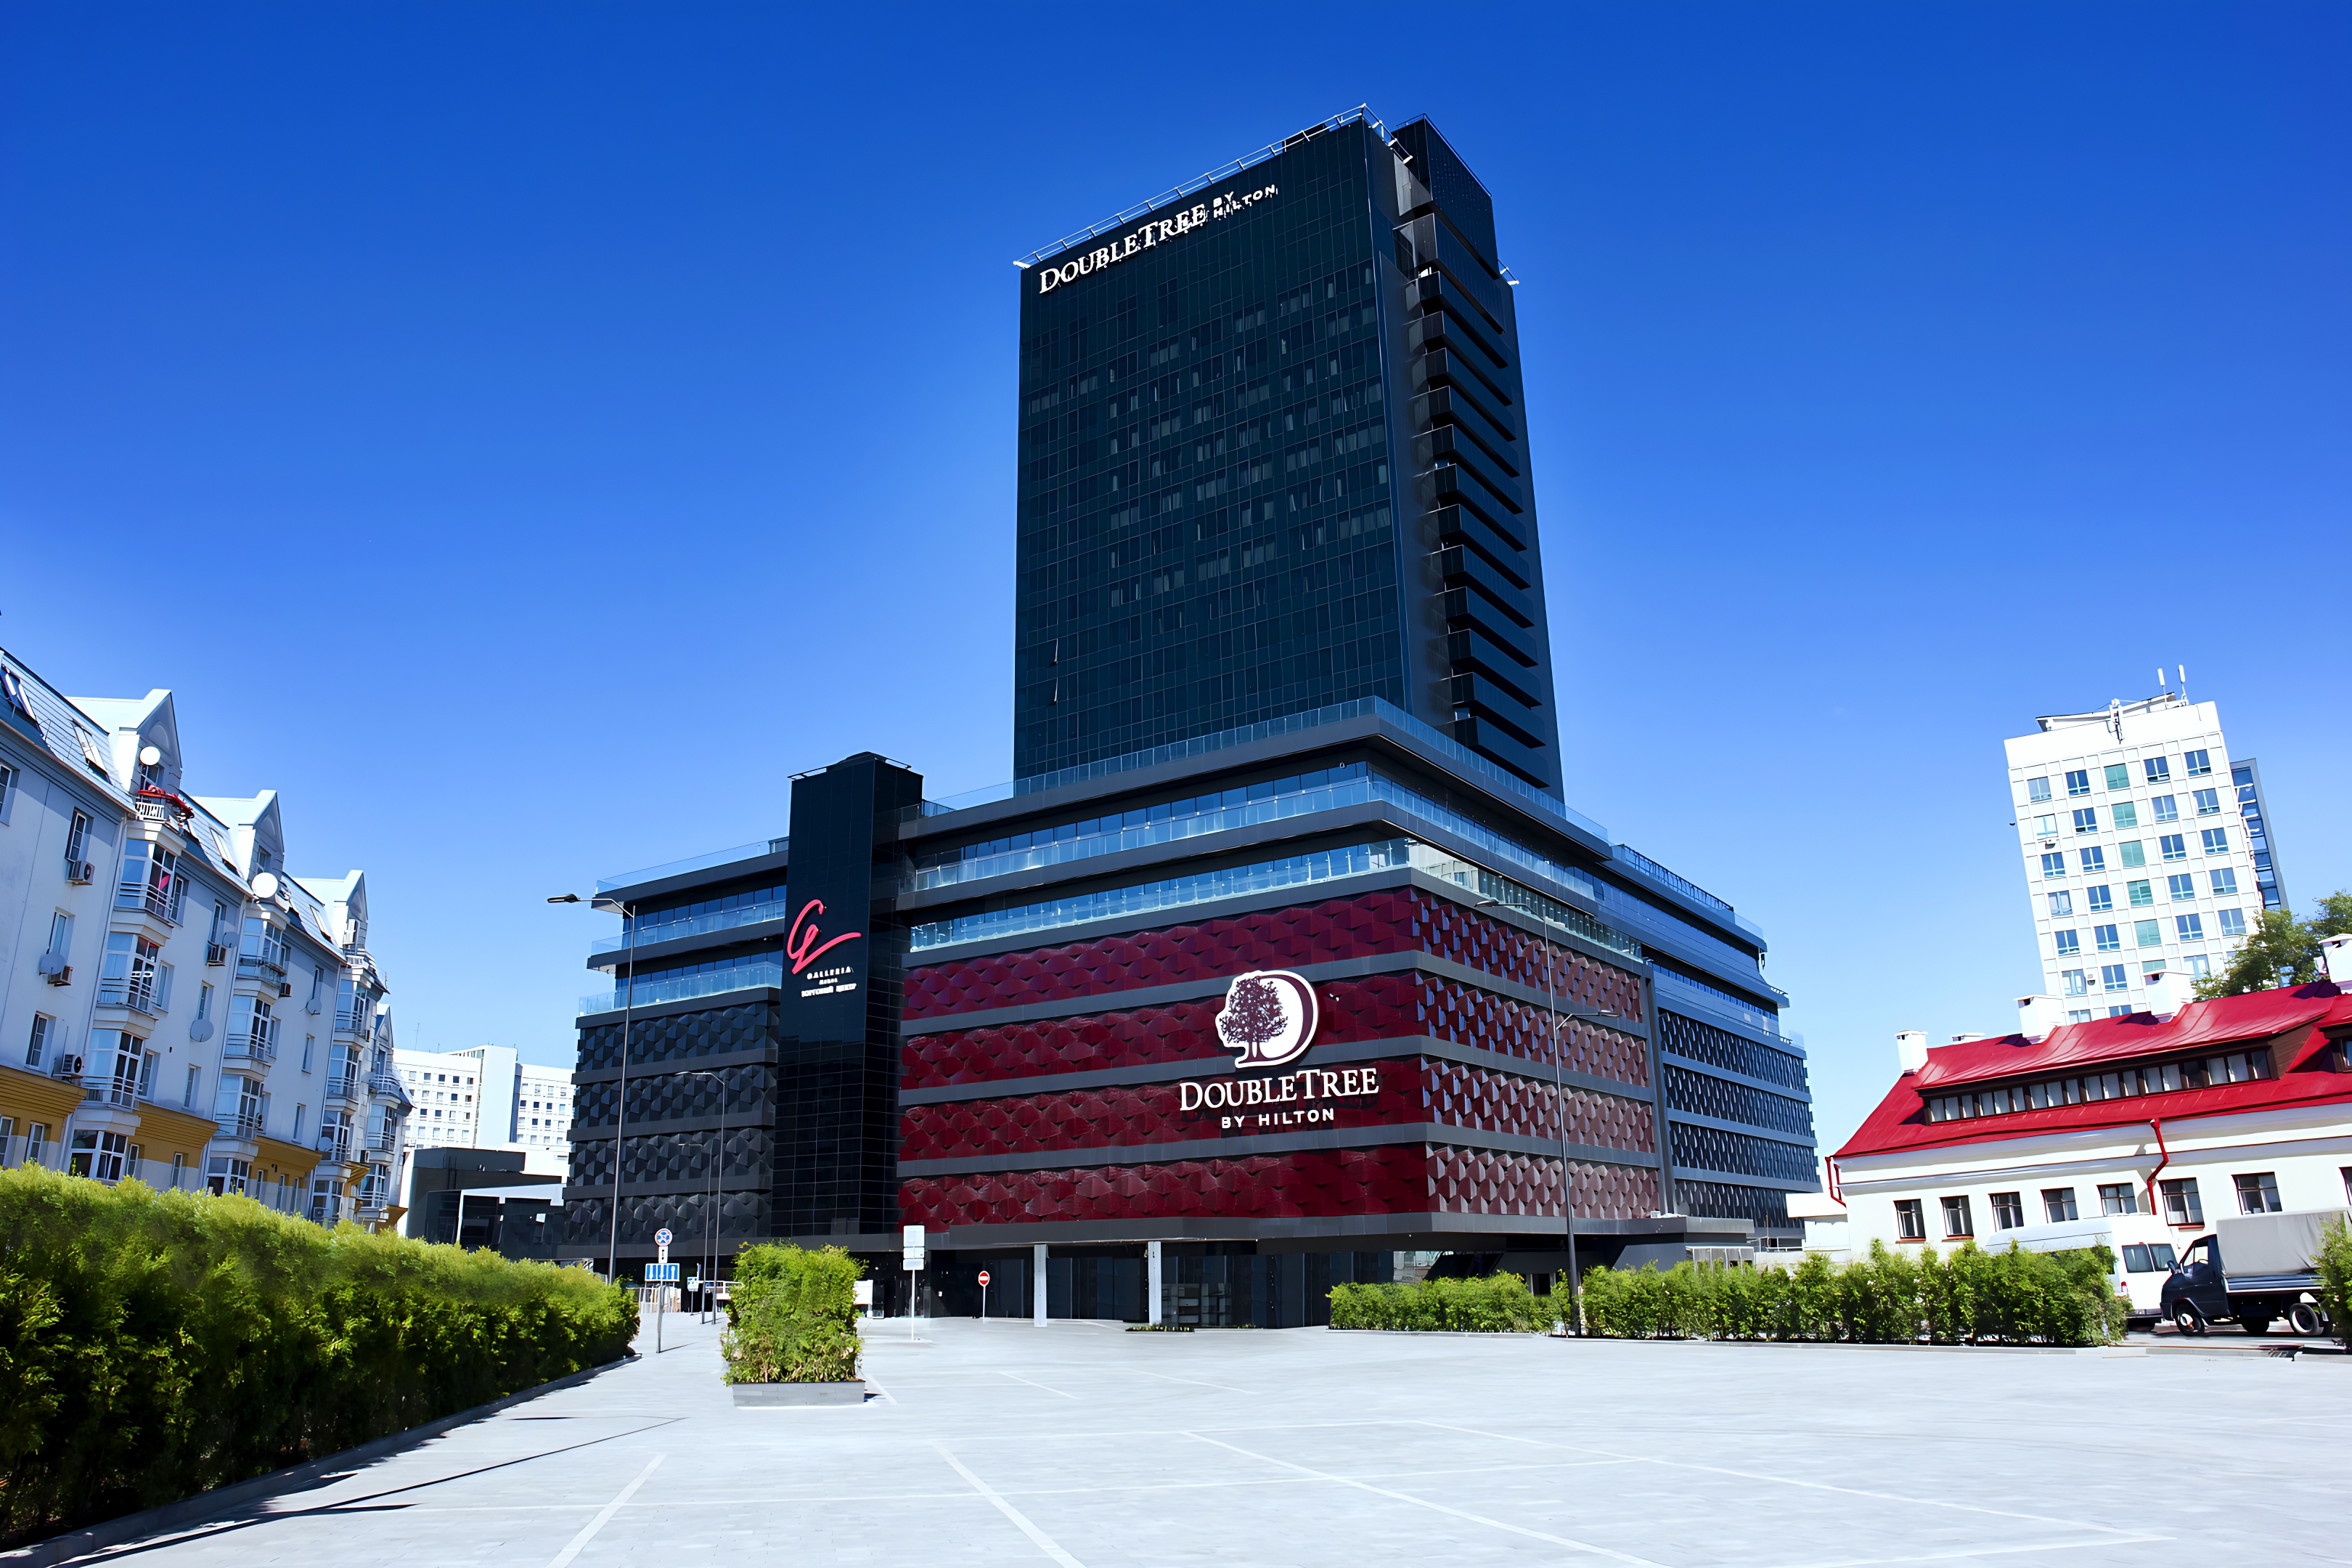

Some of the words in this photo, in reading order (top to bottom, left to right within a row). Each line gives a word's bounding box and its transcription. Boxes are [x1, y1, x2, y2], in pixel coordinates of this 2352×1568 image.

[1213, 191, 1233, 208] BY
[1213, 184, 1275, 219] HILTON
[1040, 203, 1205, 293] DOUBLETREE
[1180, 1069, 1379, 1111] DOUBLETREE
[1222, 1116, 1245, 1129] BY
[1259, 1108, 1334, 1126] HILTON
